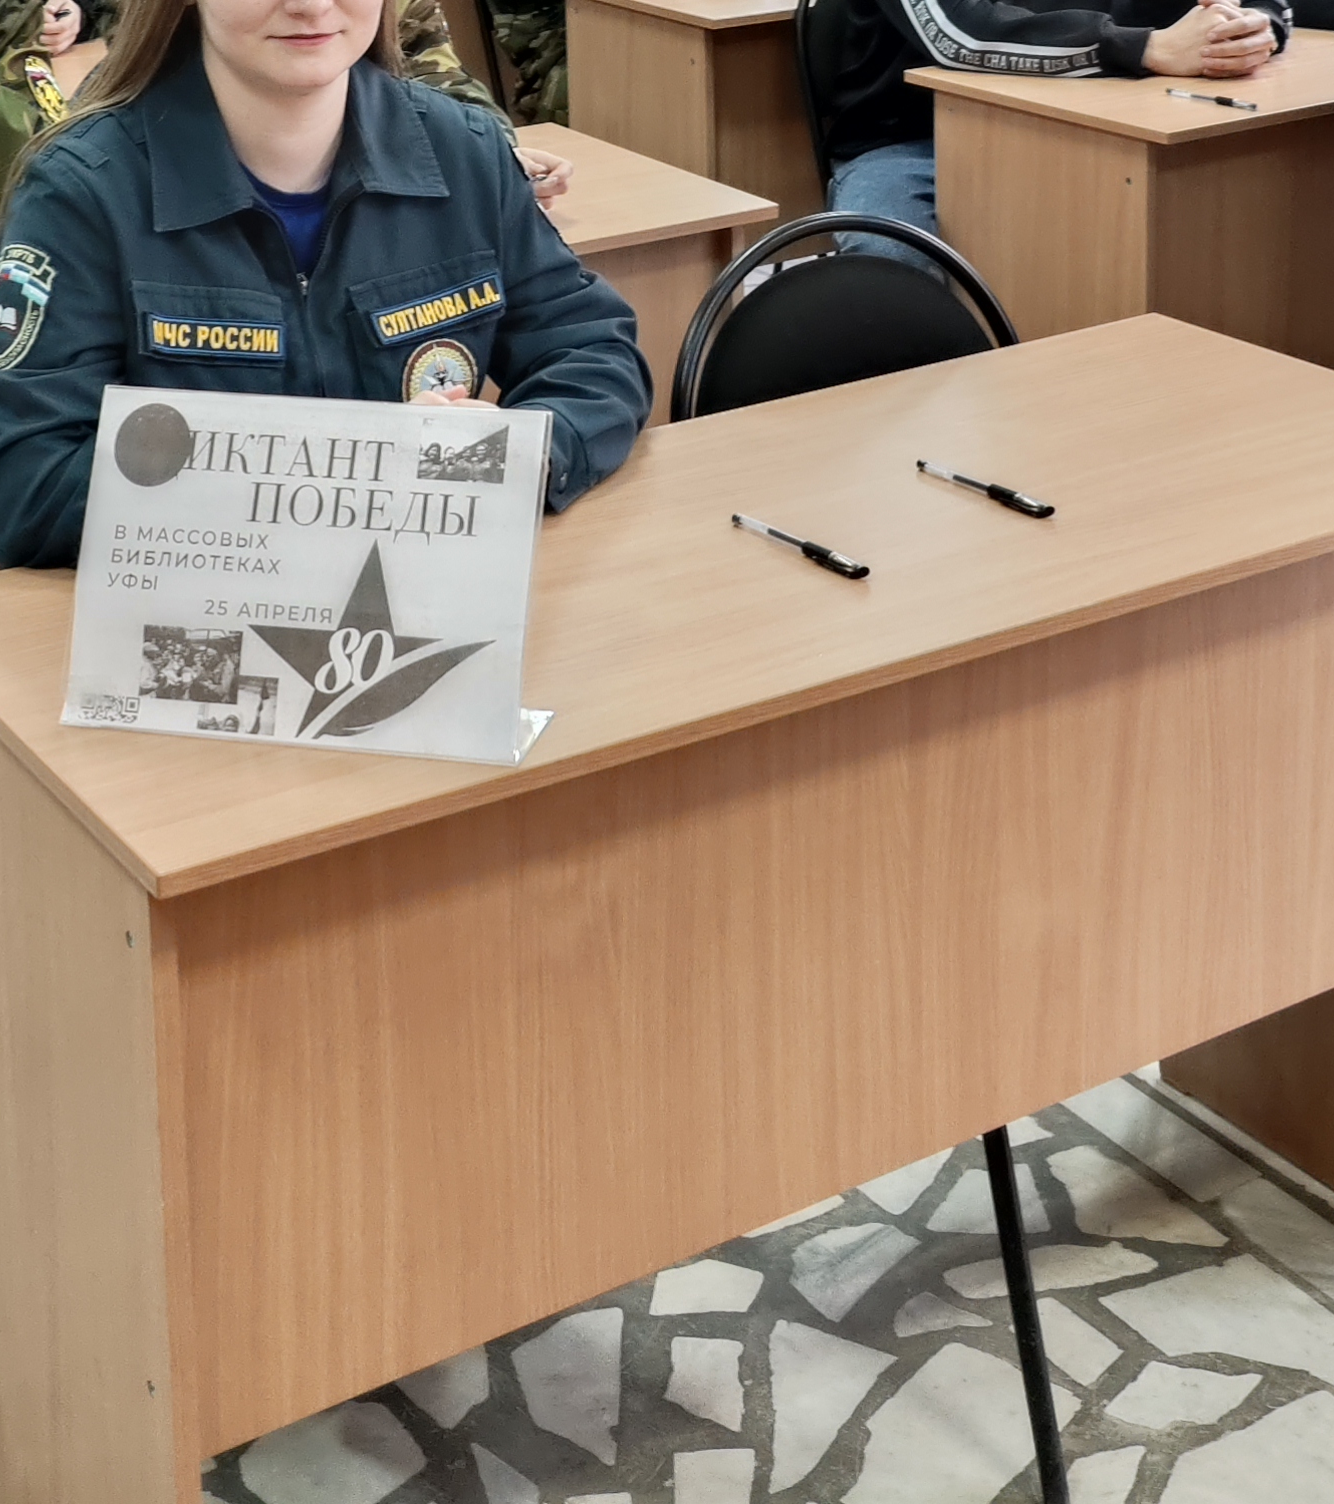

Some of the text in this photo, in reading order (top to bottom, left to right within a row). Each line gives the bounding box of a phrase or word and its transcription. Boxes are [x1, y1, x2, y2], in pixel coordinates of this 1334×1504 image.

[379, 286, 501, 338] СУЛТАНОВА А.А.
[153, 320, 279, 353] МЧС РОССИИ
[176, 429, 395, 483] ИКТАНТ
[247, 482, 480, 544] ПОБЕДЫ
[114, 525, 270, 550] В МАССОВЫХ
[111, 547, 282, 576] БИБЛИОТЕКАХ
[106, 572, 159, 591] УФЫ
[203, 599, 334, 624] 25 АПРЕЛЯ
[314, 627, 396, 694] 80
